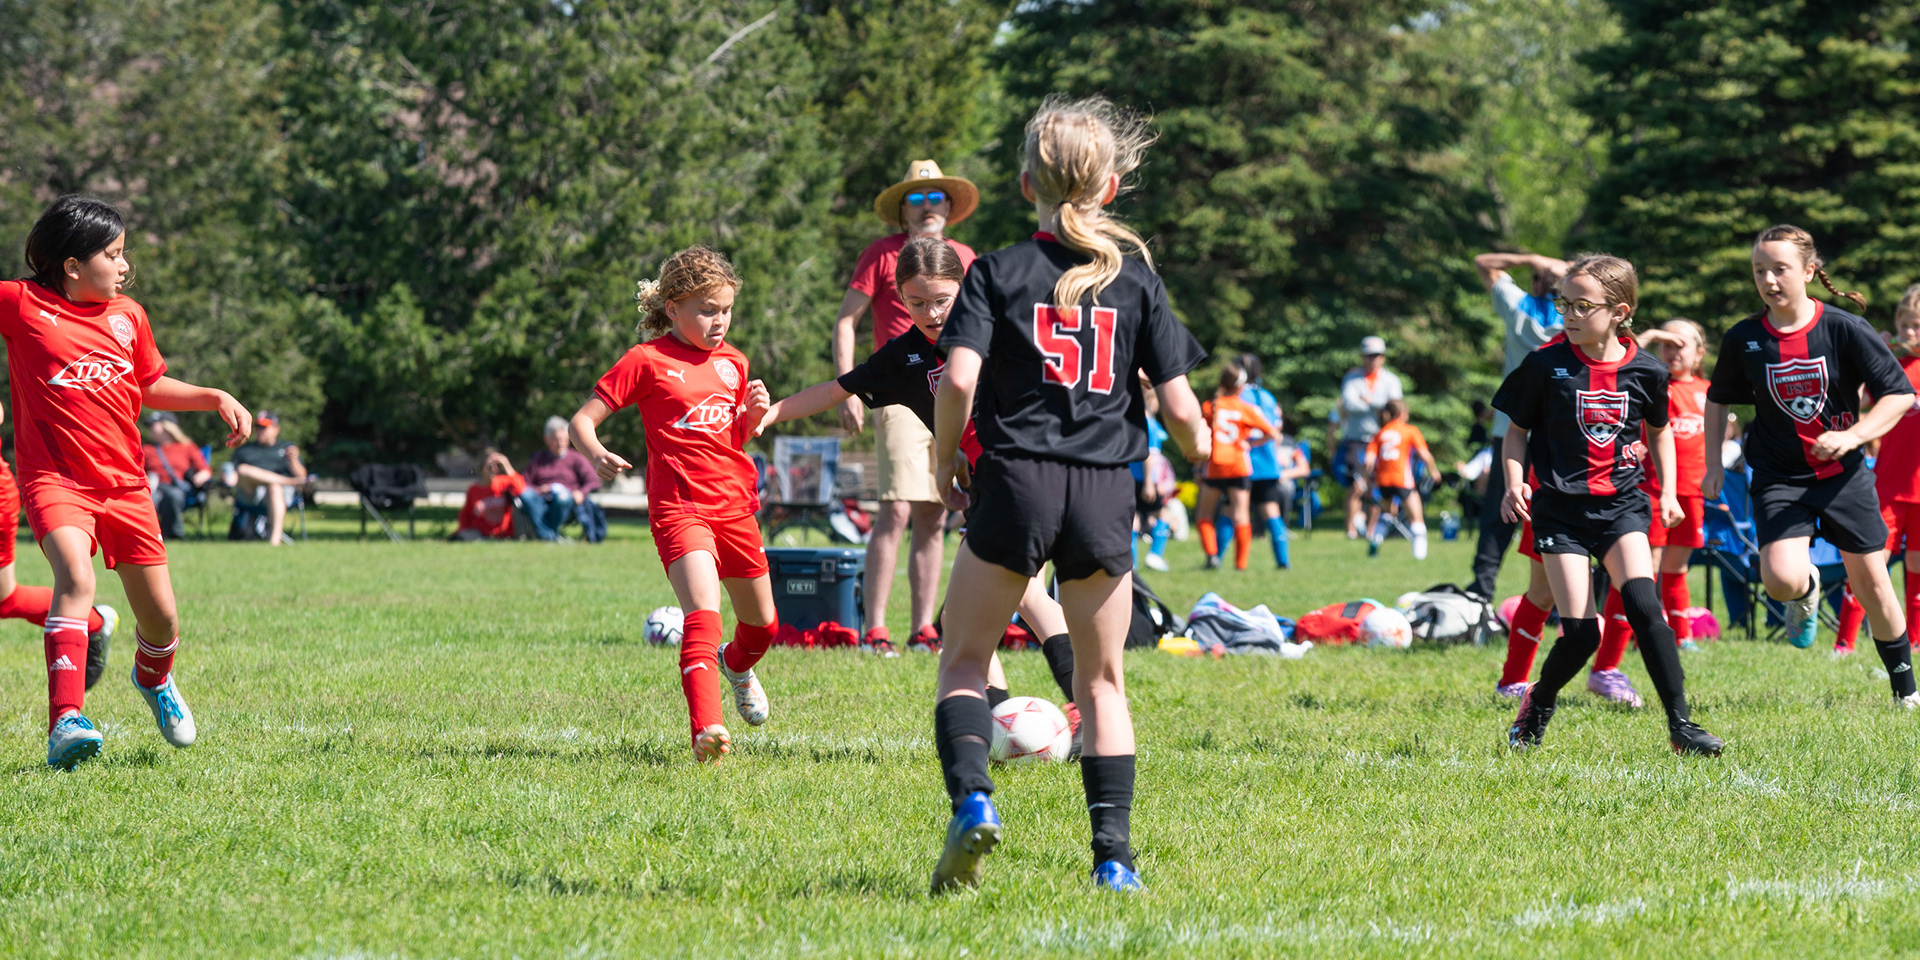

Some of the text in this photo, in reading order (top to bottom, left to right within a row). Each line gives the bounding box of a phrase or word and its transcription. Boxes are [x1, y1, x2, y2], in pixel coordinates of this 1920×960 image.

[1033, 302, 1117, 395] 51
[76, 361, 114, 381] TDS
[1786, 381, 1813, 395] PSC
[698, 405, 731, 423] TDS
[1591, 410, 1614, 421] PSC
[1214, 409, 1242, 444] 5
[1380, 429, 1402, 461] 2
[789, 583, 813, 591] YETI
